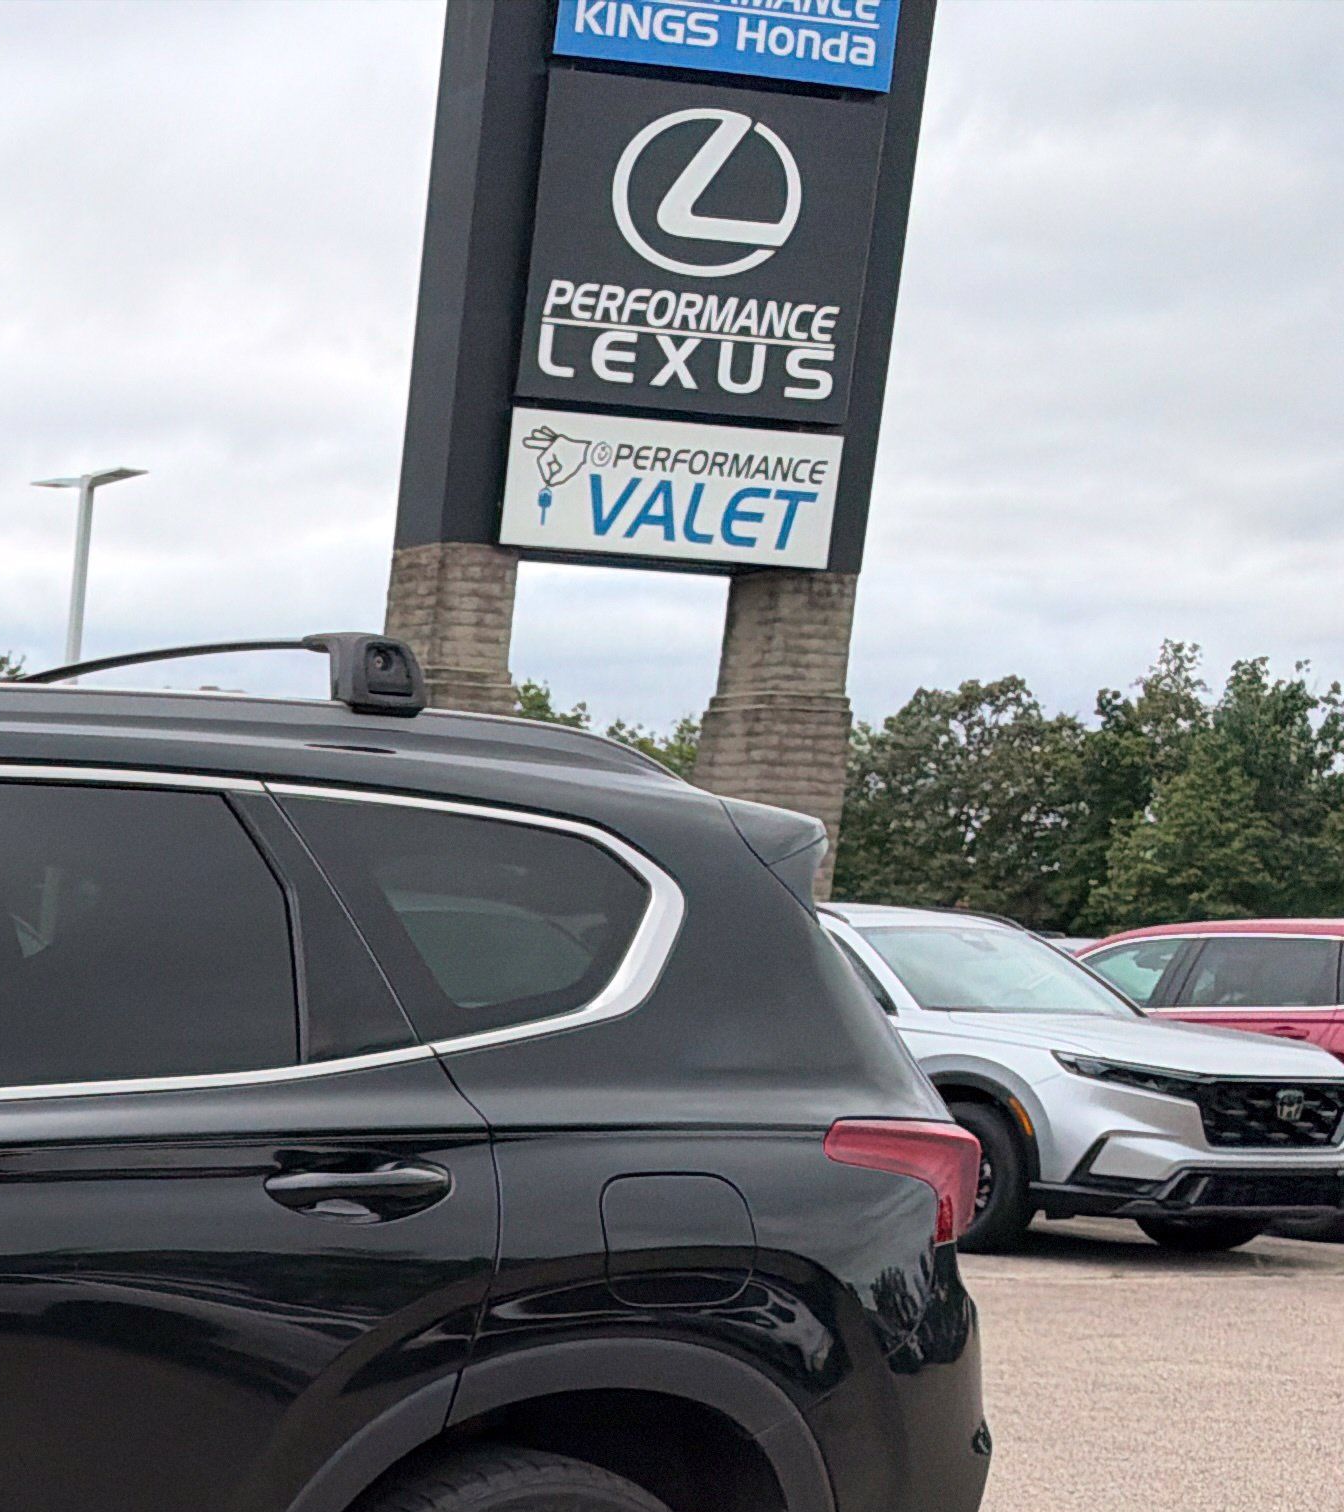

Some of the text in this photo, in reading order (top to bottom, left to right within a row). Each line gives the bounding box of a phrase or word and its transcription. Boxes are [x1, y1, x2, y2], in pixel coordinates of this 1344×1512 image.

[574, 0, 719, 48] KINGS
[736, 16, 877, 68] Honda
[542, 279, 841, 342] PERFORMANCE
[537, 323, 835, 400] LEXUS
[612, 442, 829, 485] PERFORMANCE
[589, 473, 819, 550] VALET
